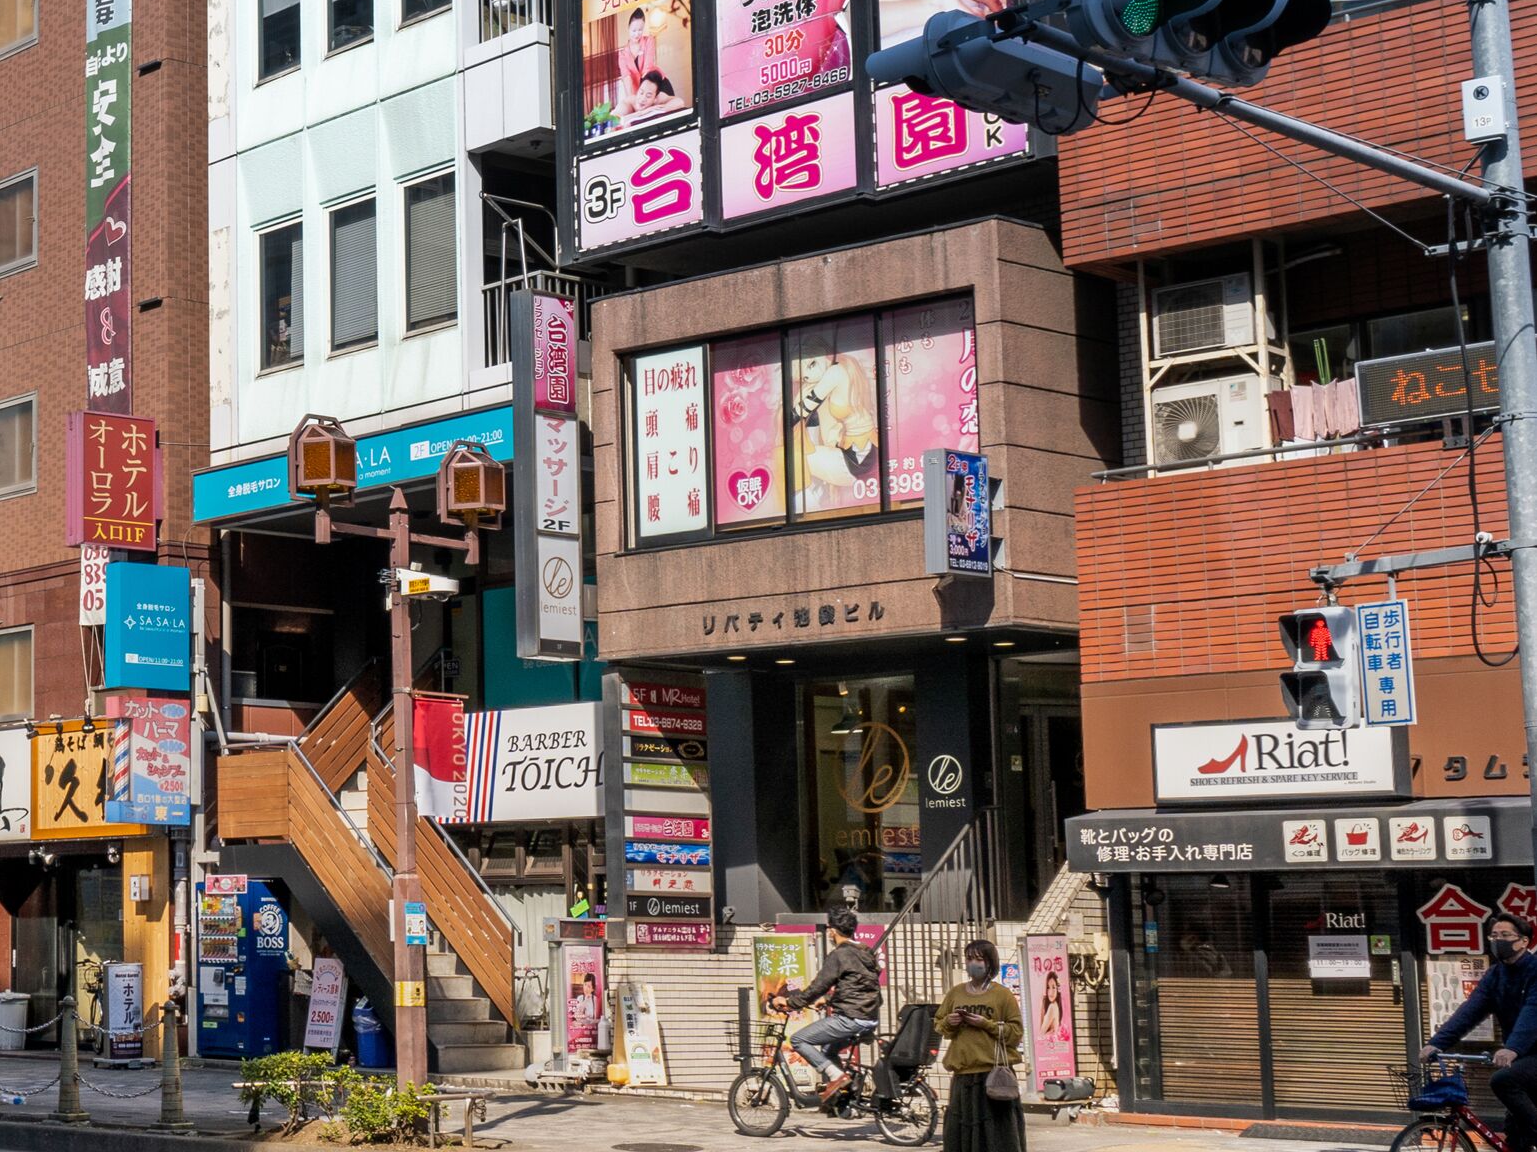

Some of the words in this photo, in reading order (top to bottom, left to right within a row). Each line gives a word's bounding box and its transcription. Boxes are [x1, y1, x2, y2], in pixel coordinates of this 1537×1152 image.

[764, 29, 805, 57] 30分
[760, 57, 812, 85] 5000円
[729, 67, 848, 112] TEL:03-5927-8466
[89, 80, 117, 188] 安全
[585, 175, 625, 223] 3F
[630, 88, 969, 226] 台湾園
[547, 314, 569, 404] 台湾園
[898, 337, 912, 374] 心も
[644, 362, 697, 396] 目の疲れ
[646, 403, 698, 438] 頭痛
[89, 421, 113, 517] オーロラ
[121, 424, 149, 519] ホテル
[365, 467, 391, 479] moment
[543, 415, 567, 517] マッサージ
[647, 447, 698, 480] 肩こり
[227, 478, 281, 499] 全身脱毛サロン
[737, 477, 762, 492] 仮眠
[853, 479, 878, 499] 03
[648, 488, 700, 521] 腰痛
[737, 490, 763, 506] OK!
[543, 519, 570, 531] 2F
[965, 476, 979, 552] モナリザ
[93, 523, 146, 544] 入口1F
[137, 603, 176, 611] 全身脱毛サロン
[541, 604, 577, 616] lemiest
[701, 600, 886, 636] リバティ池袋ビル
[1364, 612, 1384, 672] 自転車
[1383, 609, 1402, 671] 歩行者
[633, 688, 646, 702] 5F
[1379, 677, 1397, 718] 専用
[125, 700, 158, 718] カット
[143, 721, 179, 738] パーマ
[452, 700, 464, 765] TOKYO
[507, 729, 586, 754] BARBER
[1252, 730, 1349, 771] Riat!
[1191, 777, 1218, 786] SHOES
[1220, 776, 1260, 785] REFRESH
[1270, 774, 1299, 783] SPARE
[1301, 773, 1318, 782] KEY
[1321, 772, 1358, 781] SERVICE
[453, 773, 467, 819] 2020
[925, 797, 966, 808] lemiest
[663, 819, 693, 837] 台湾園
[1080, 827, 1174, 846] 靴とバッグの
[657, 852, 699, 864] モナリザ
[1096, 843, 1253, 862] 修理・お手入れ専門店
[1342, 848, 1376, 856] バッグ修理
[629, 902, 637, 911] 1F
[662, 901, 700, 914] lemiest
[1326, 913, 1366, 929] Riat!
[257, 937, 284, 948] BOSS
[123, 983, 134, 1025] ホテル
[311, 1010, 334, 1024] 2,500円
